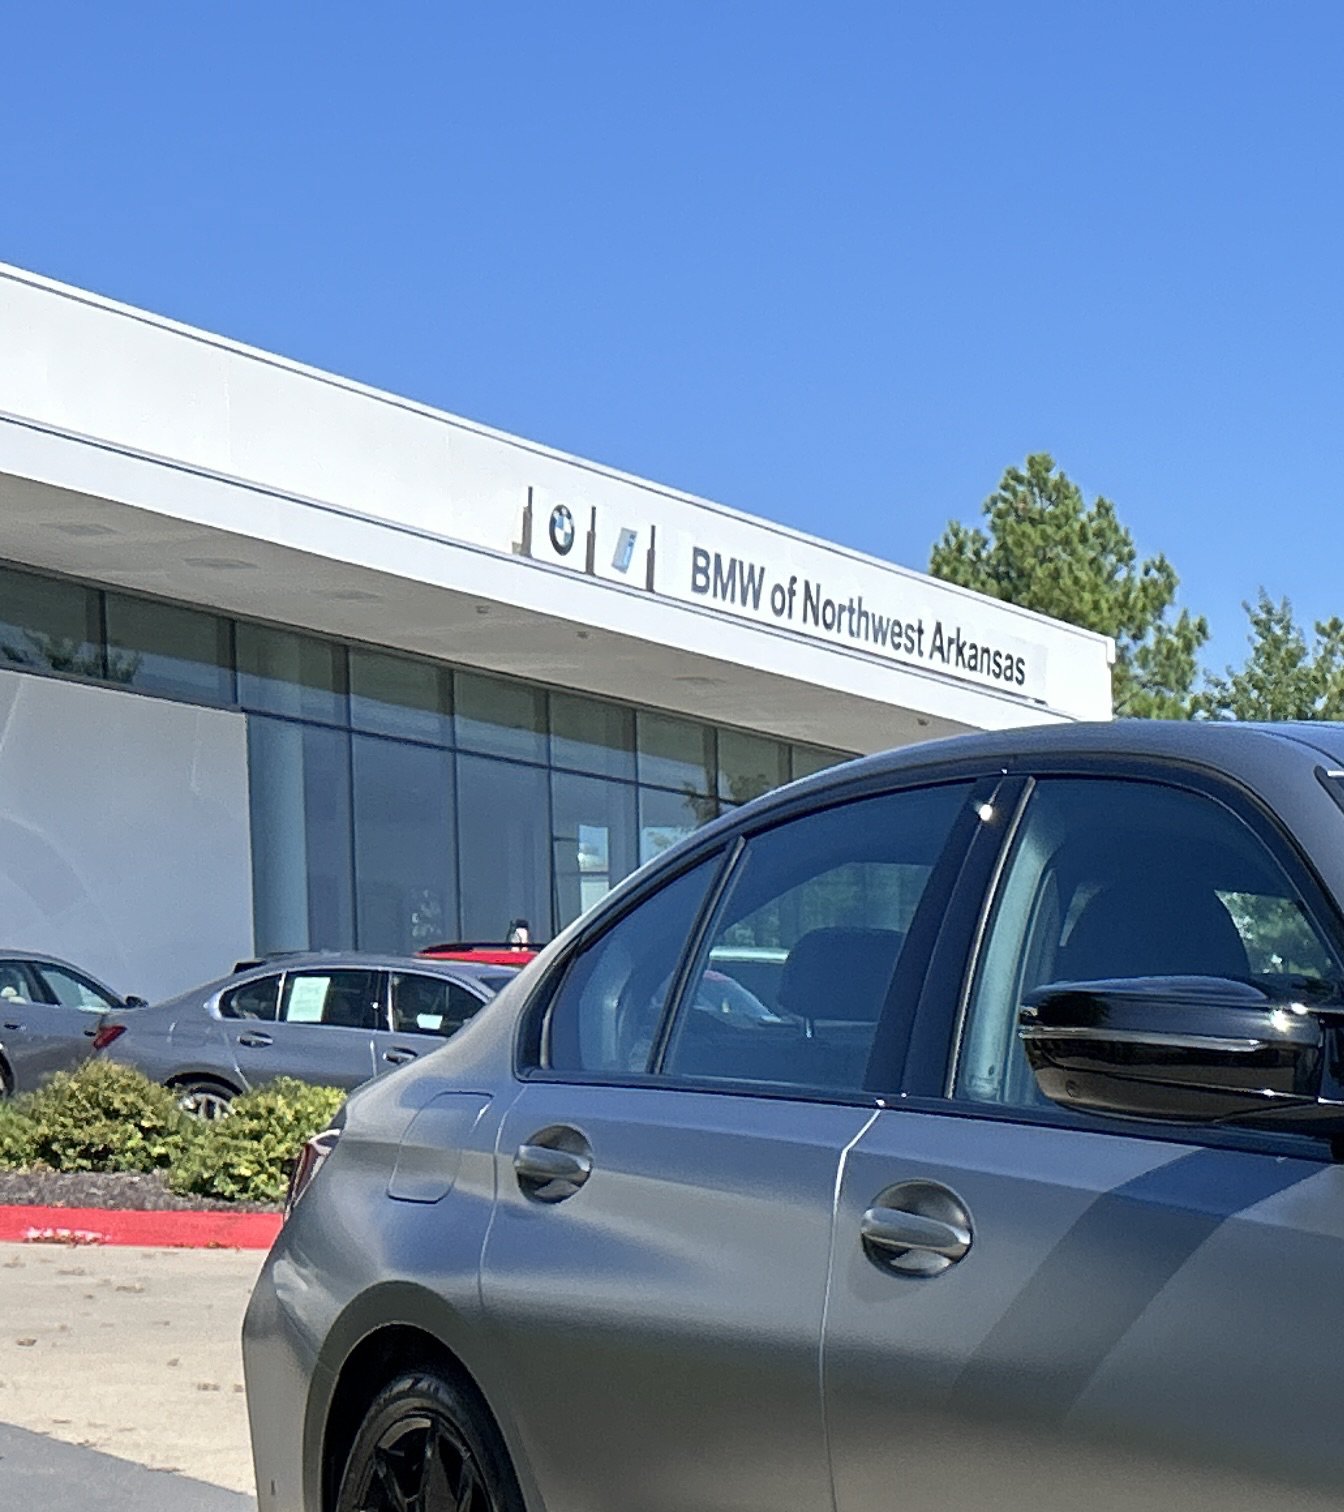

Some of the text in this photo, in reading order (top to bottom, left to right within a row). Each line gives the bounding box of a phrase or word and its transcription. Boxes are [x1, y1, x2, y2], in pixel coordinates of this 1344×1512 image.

[691, 546, 1026, 686] BMW of Northwest Arkansas
